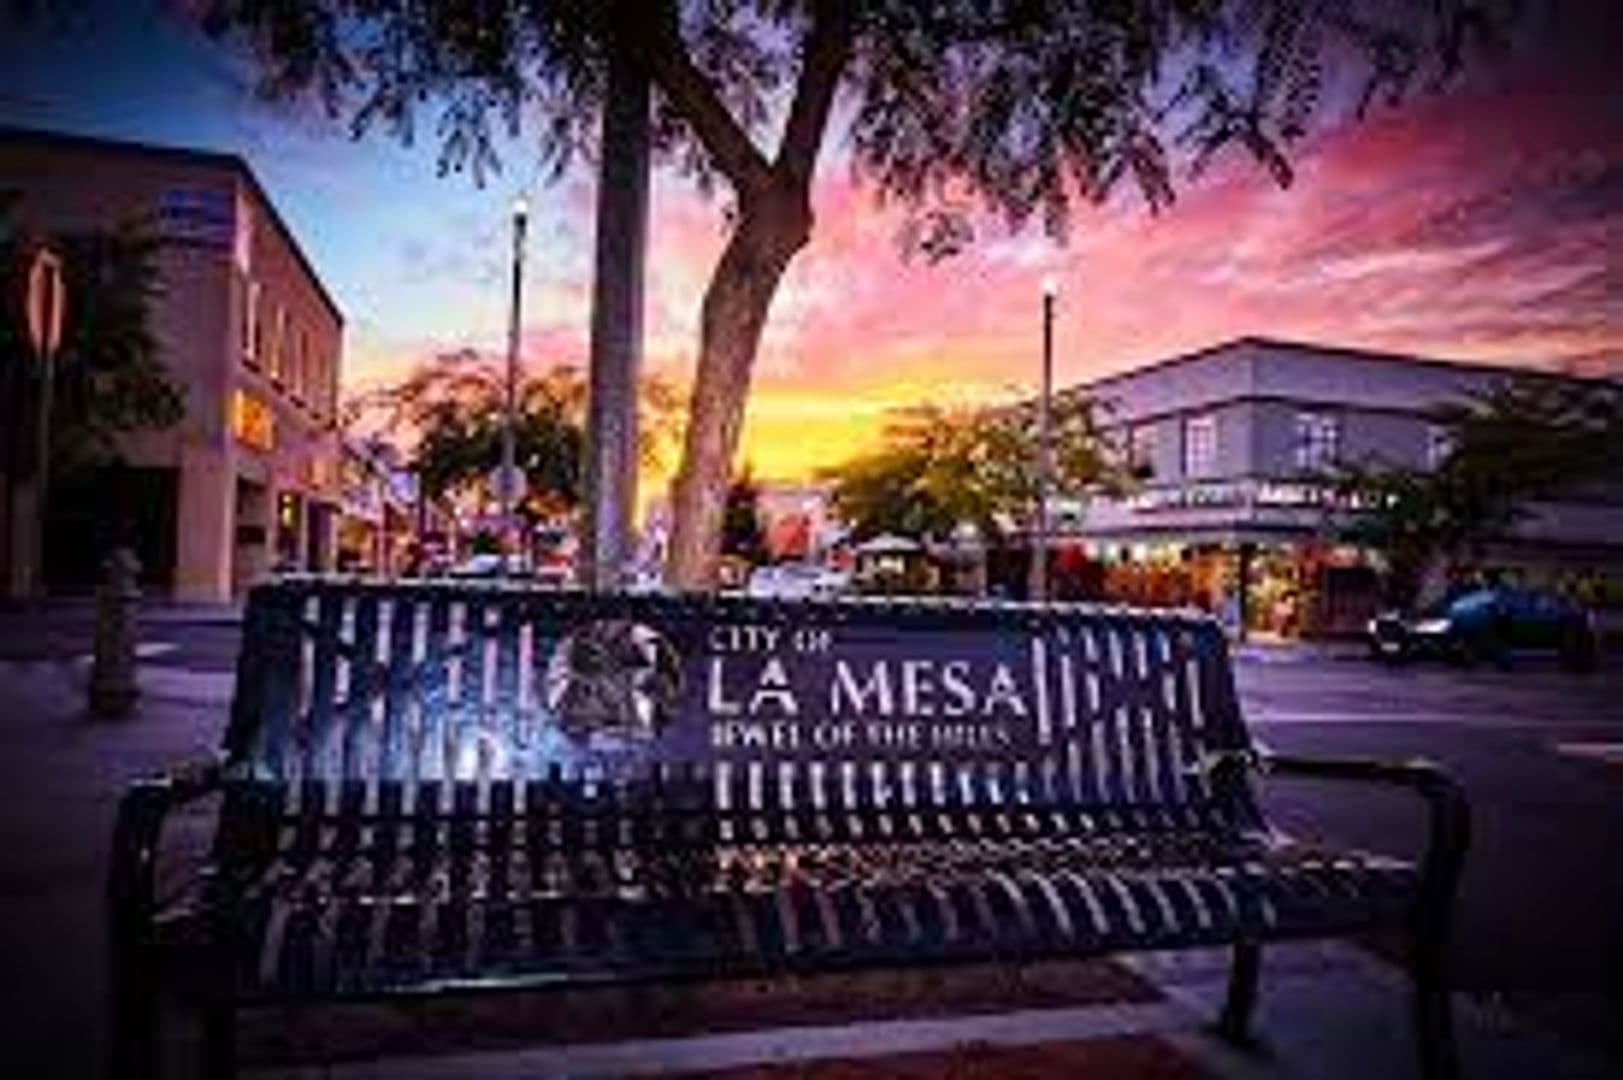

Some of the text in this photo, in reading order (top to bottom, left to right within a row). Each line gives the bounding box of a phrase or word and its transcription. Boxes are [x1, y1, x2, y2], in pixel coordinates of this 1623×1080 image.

[709, 625, 832, 651] CITY OF
[708, 657, 1028, 716] LA MESA
[813, 724, 860, 749] OF
[866, 724, 921, 748] THE
